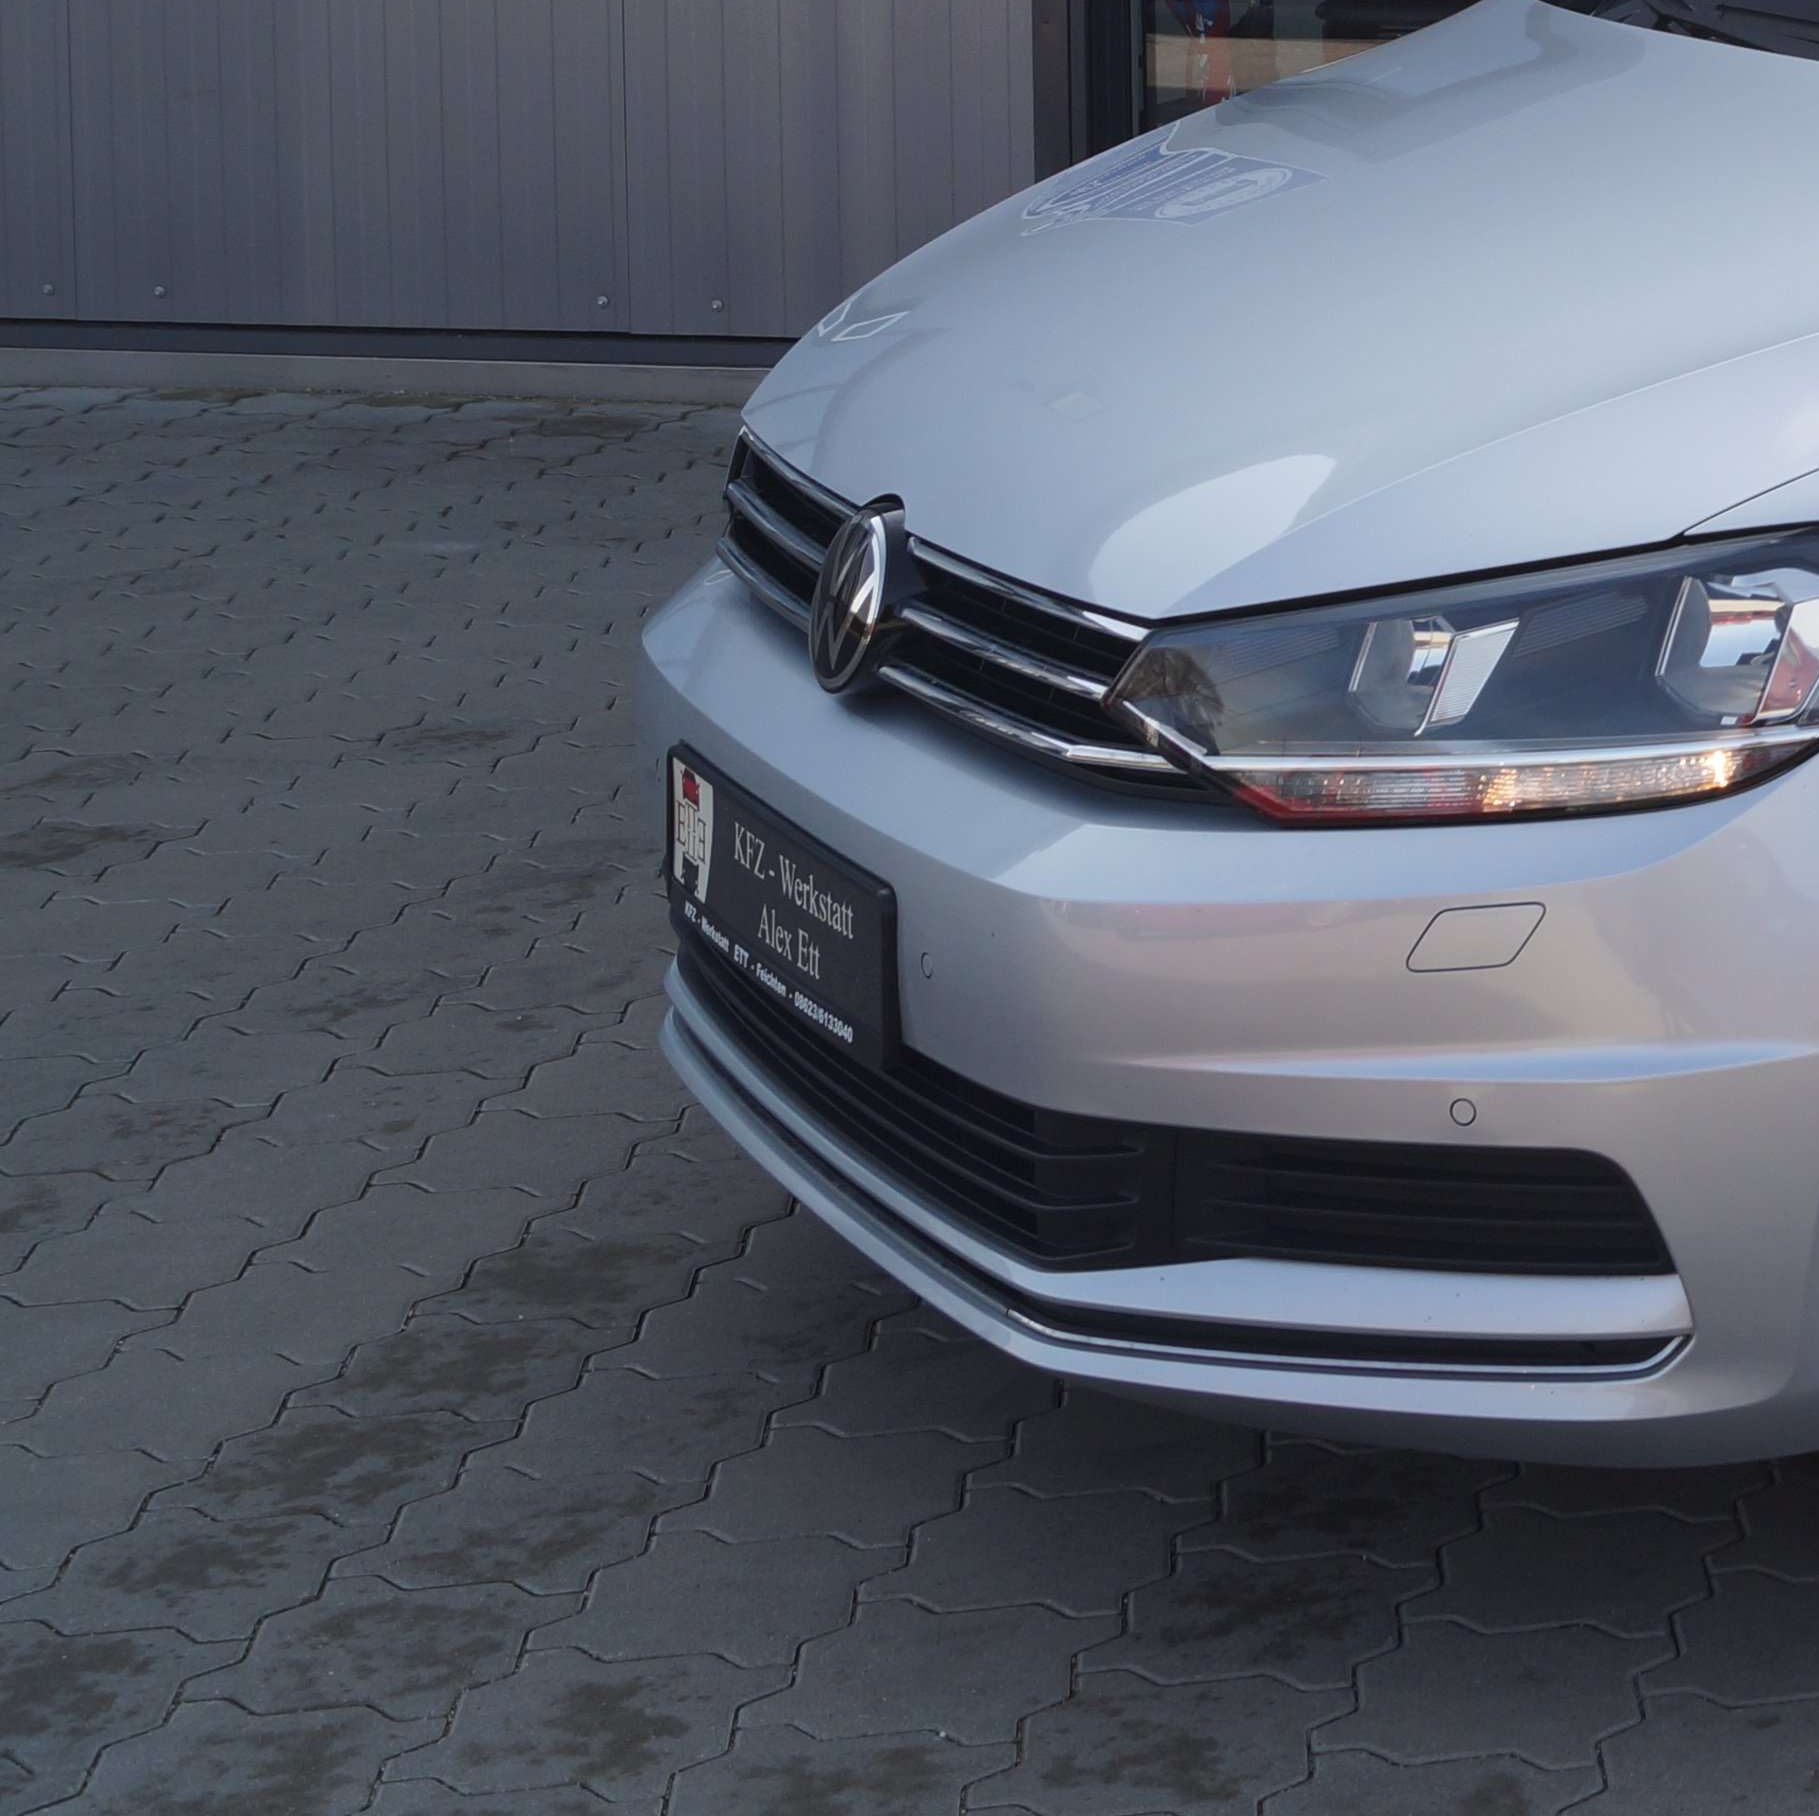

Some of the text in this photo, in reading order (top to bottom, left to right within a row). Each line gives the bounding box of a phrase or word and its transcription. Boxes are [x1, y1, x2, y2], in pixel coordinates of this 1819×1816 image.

[733, 821, 766, 880] KFZ
[779, 854, 854, 940] Werkstatt
[734, 944, 750, 968] ETT
[758, 904, 821, 980] Alex Ett
